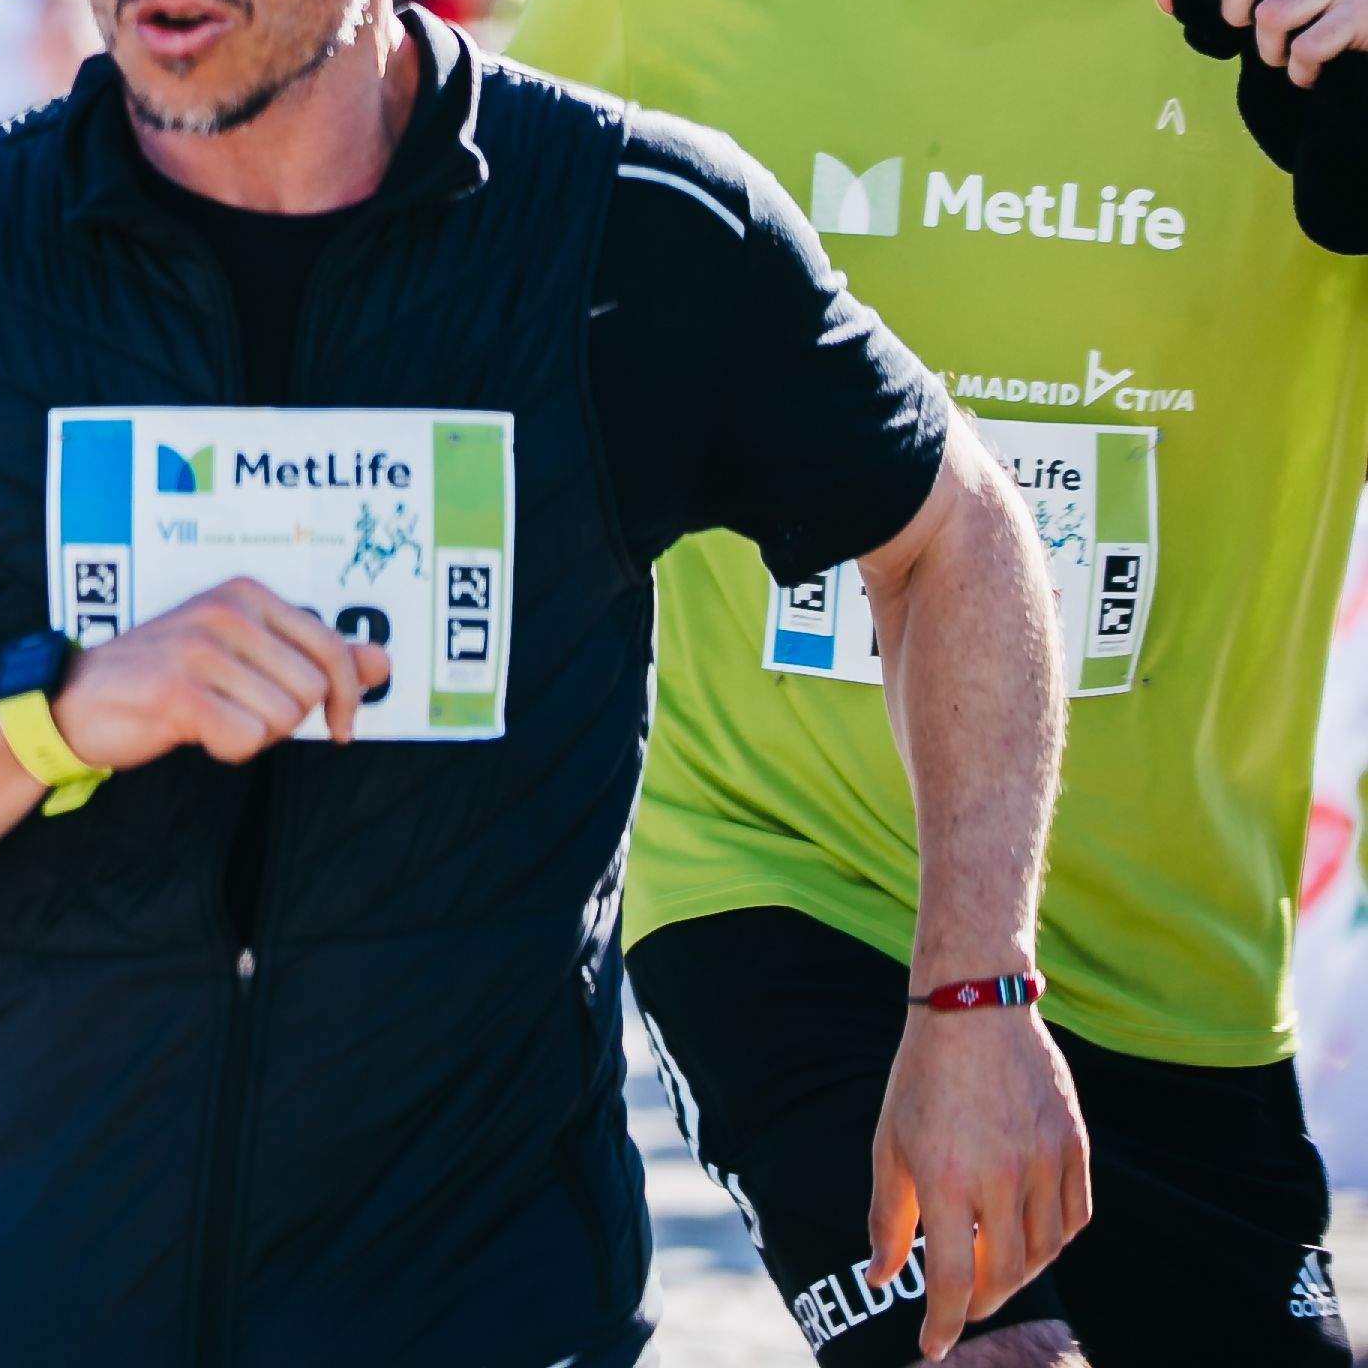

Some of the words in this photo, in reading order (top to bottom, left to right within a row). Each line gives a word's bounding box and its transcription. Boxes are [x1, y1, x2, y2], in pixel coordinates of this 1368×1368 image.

[922, 170, 1186, 250] MetLife
[233, 452, 413, 490] MetLife
[1012, 458, 1082, 491] Life
